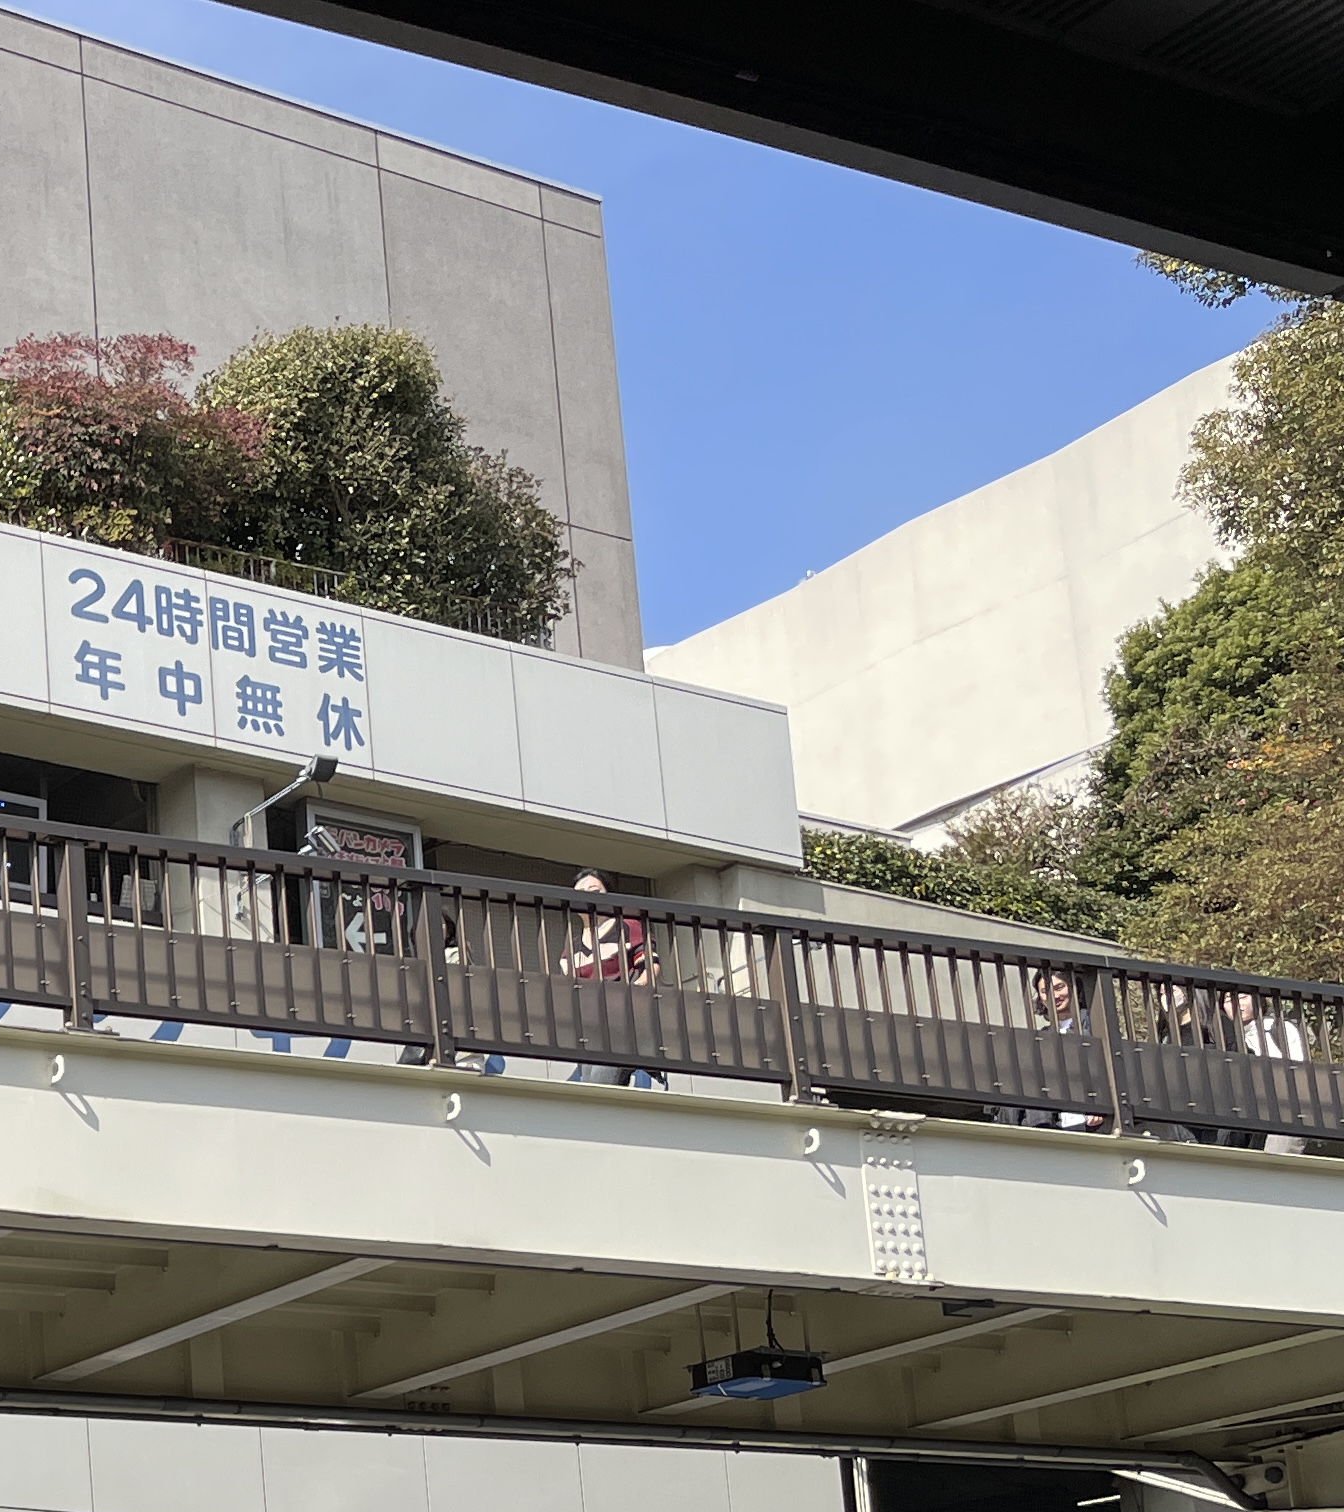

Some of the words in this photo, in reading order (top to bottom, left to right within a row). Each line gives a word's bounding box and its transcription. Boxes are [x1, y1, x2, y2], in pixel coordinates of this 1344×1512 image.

[68, 567, 365, 683] 24時間営業
[73, 639, 366, 752] 年中無休
